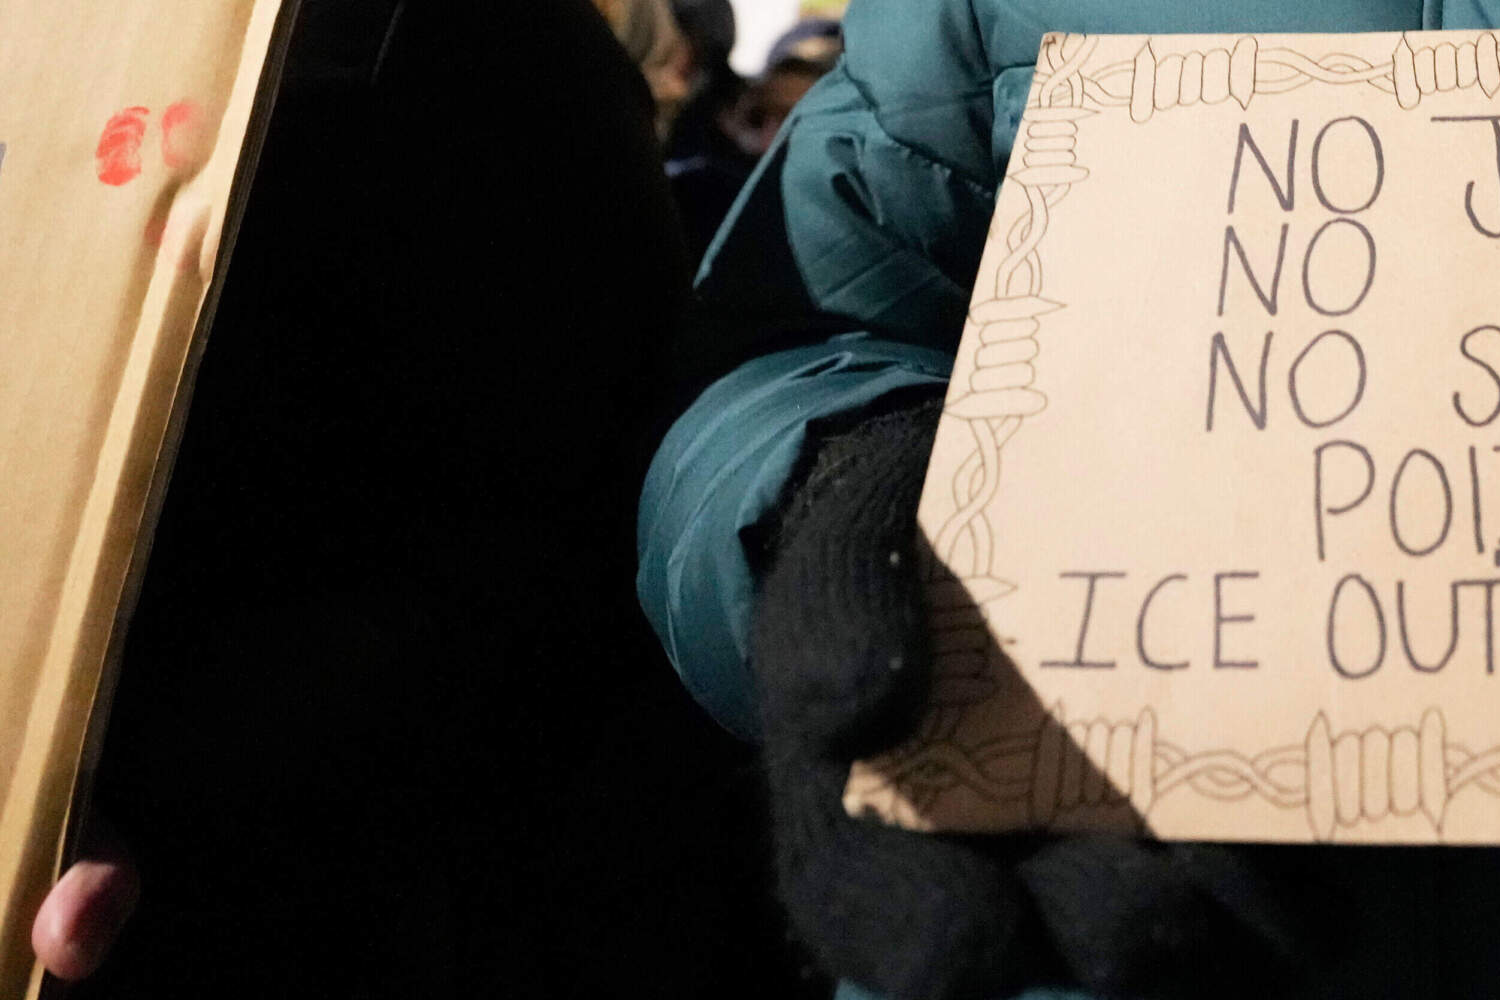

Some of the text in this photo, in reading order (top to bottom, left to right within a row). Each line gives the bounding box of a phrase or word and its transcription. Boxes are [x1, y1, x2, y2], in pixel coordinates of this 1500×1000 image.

[1228, 115, 1385, 216] NO
[1217, 216, 1377, 317] NO
[1205, 329, 1367, 433] NO
[1040, 571, 1260, 672] ICE
